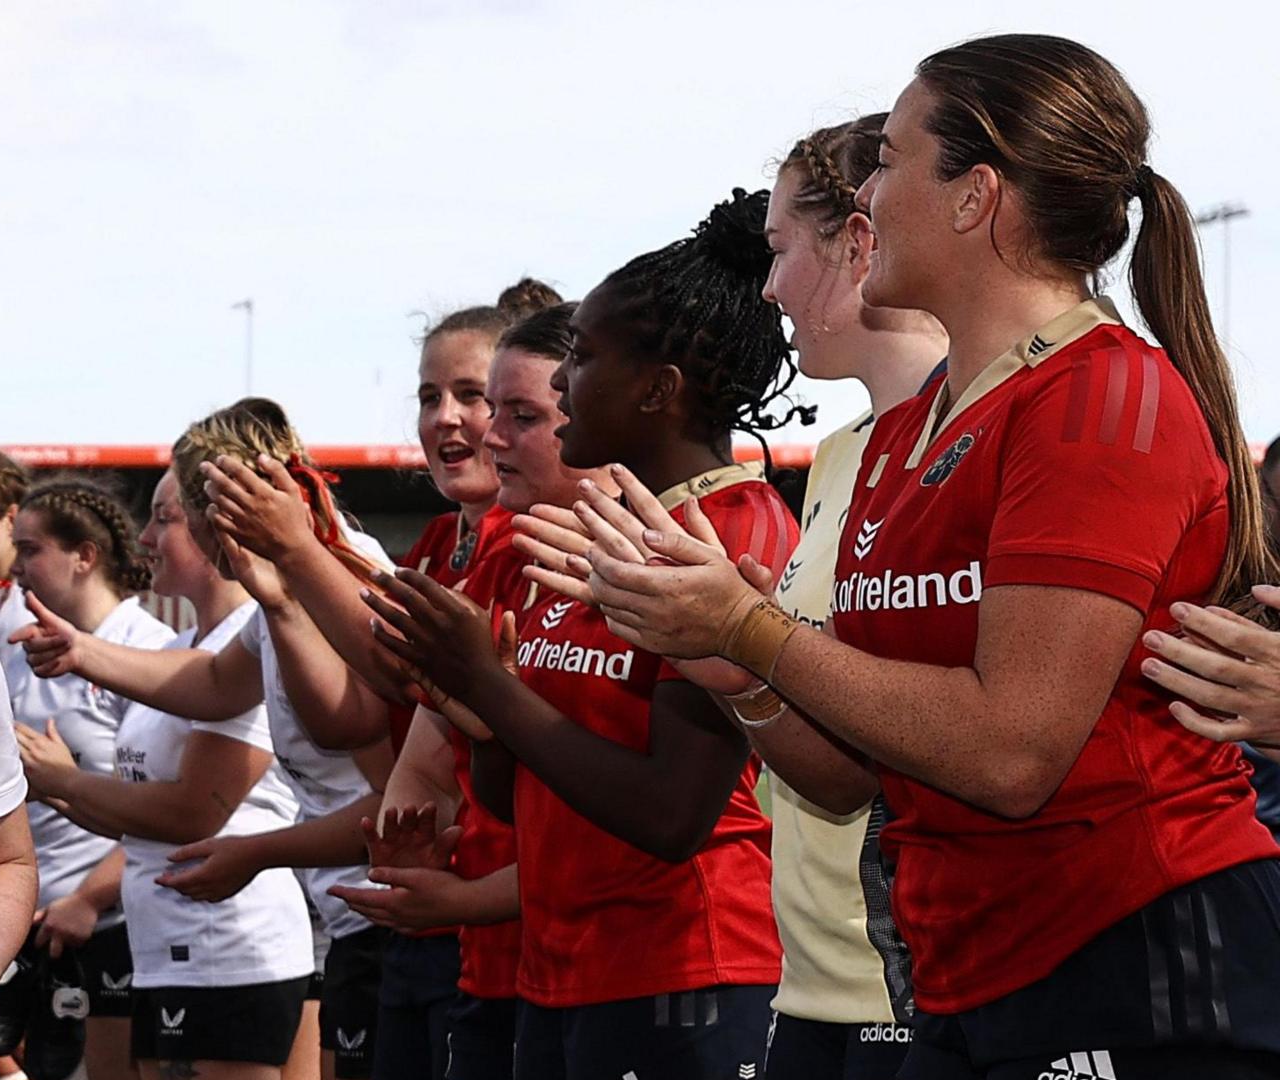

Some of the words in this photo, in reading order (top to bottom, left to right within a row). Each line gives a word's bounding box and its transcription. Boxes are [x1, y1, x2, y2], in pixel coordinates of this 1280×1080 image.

[840, 573, 857, 612] of
[856, 561, 982, 612] Ireland
[518, 637, 541, 666] of
[534, 638, 634, 680] Ireland
